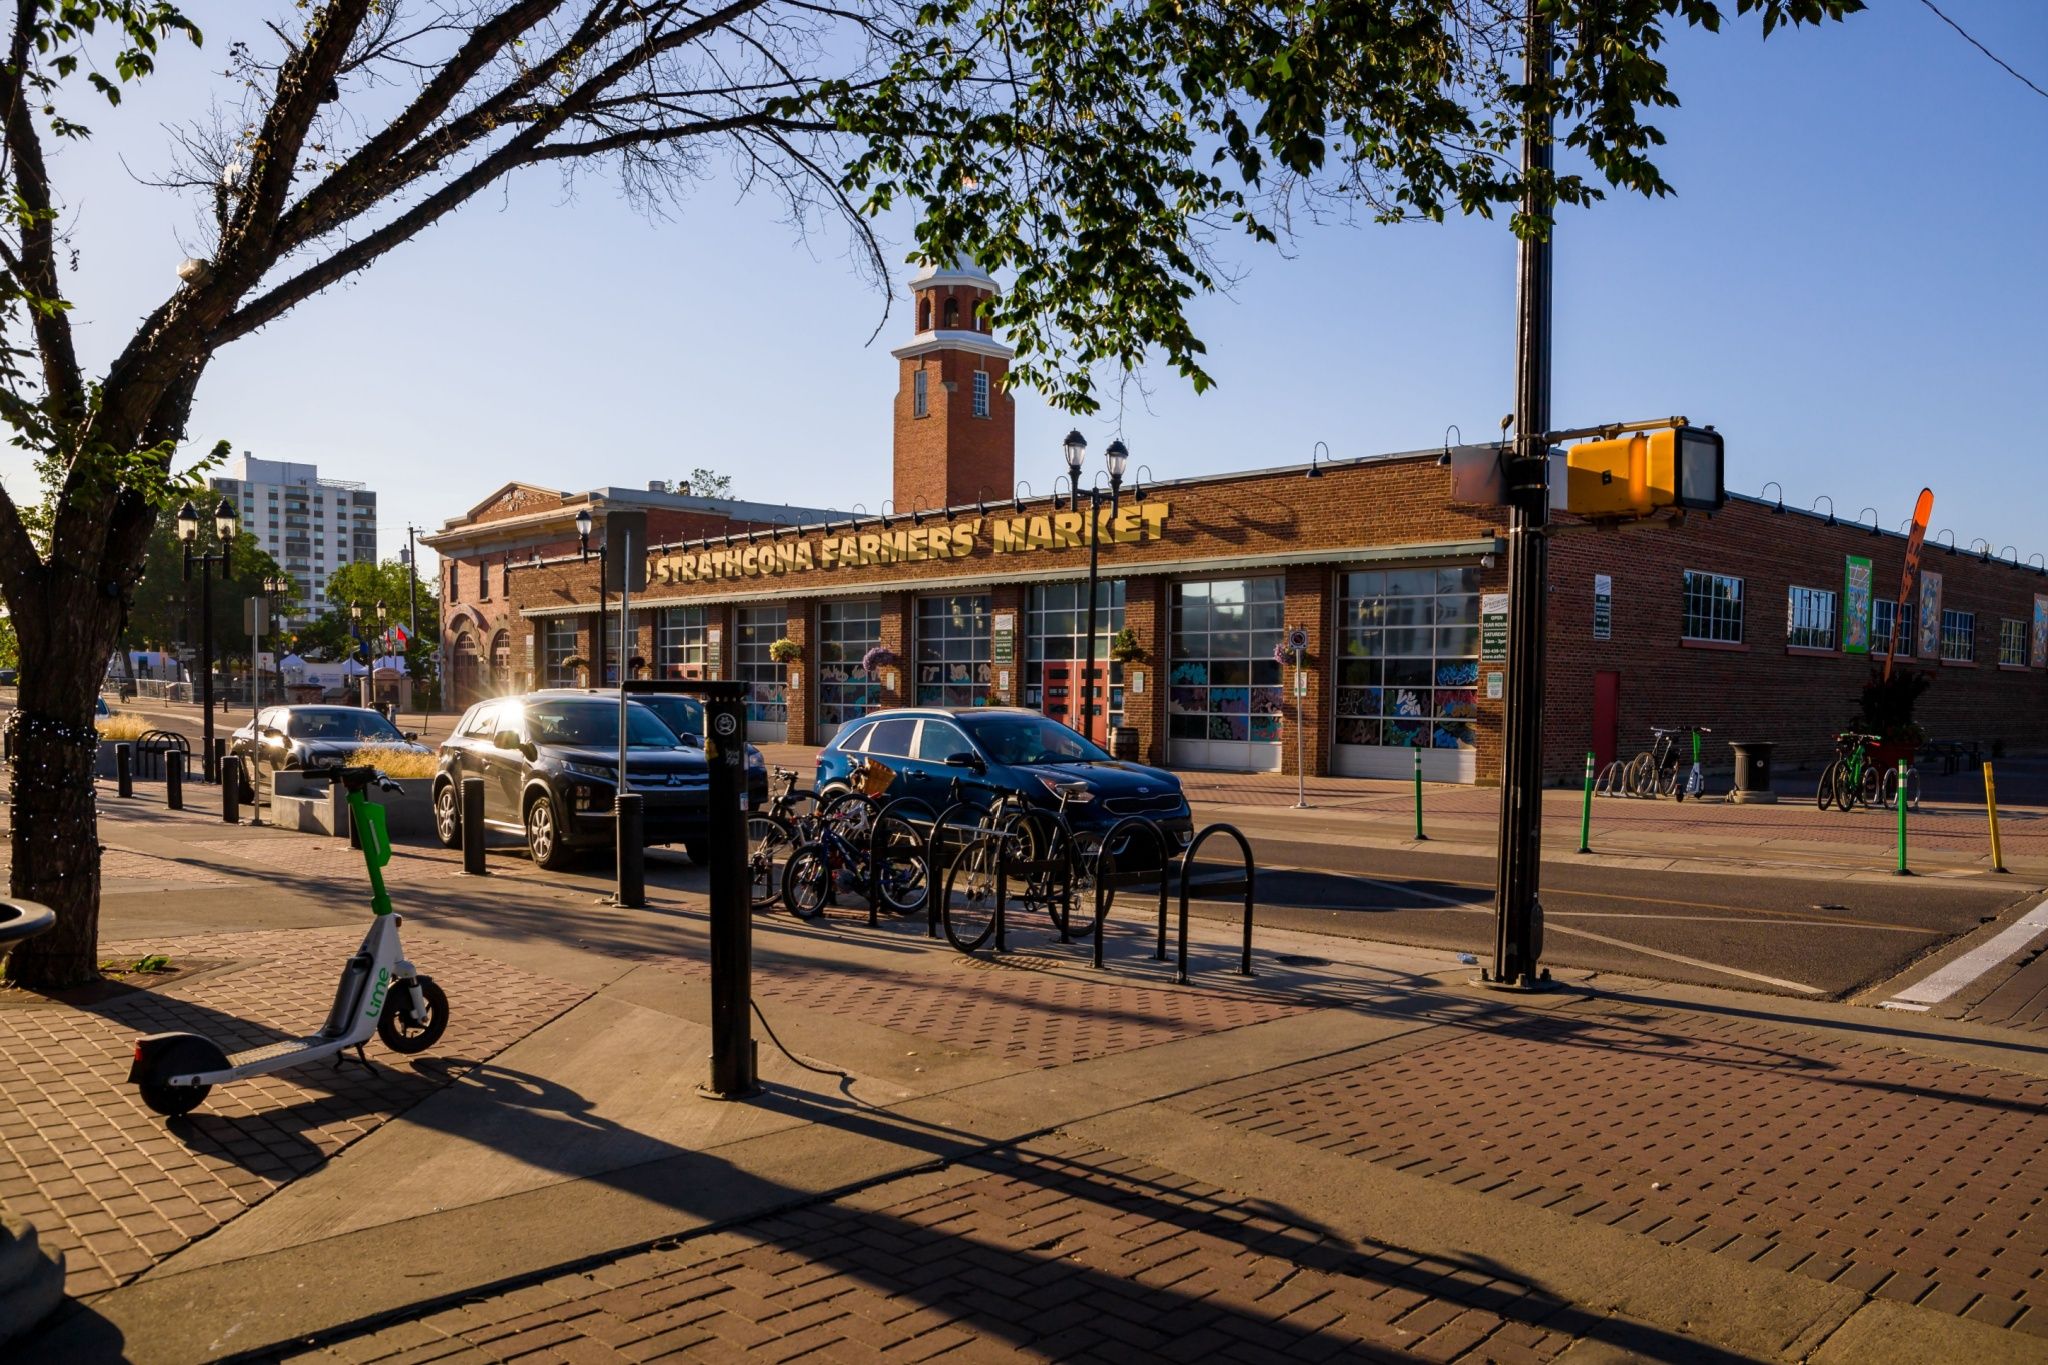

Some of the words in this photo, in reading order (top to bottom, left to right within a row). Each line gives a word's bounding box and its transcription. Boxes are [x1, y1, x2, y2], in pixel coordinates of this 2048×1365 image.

[656, 541, 814, 584] STRATHCONA
[993, 503, 1169, 553] MARKET
[365, 967, 389, 1018] Lime
